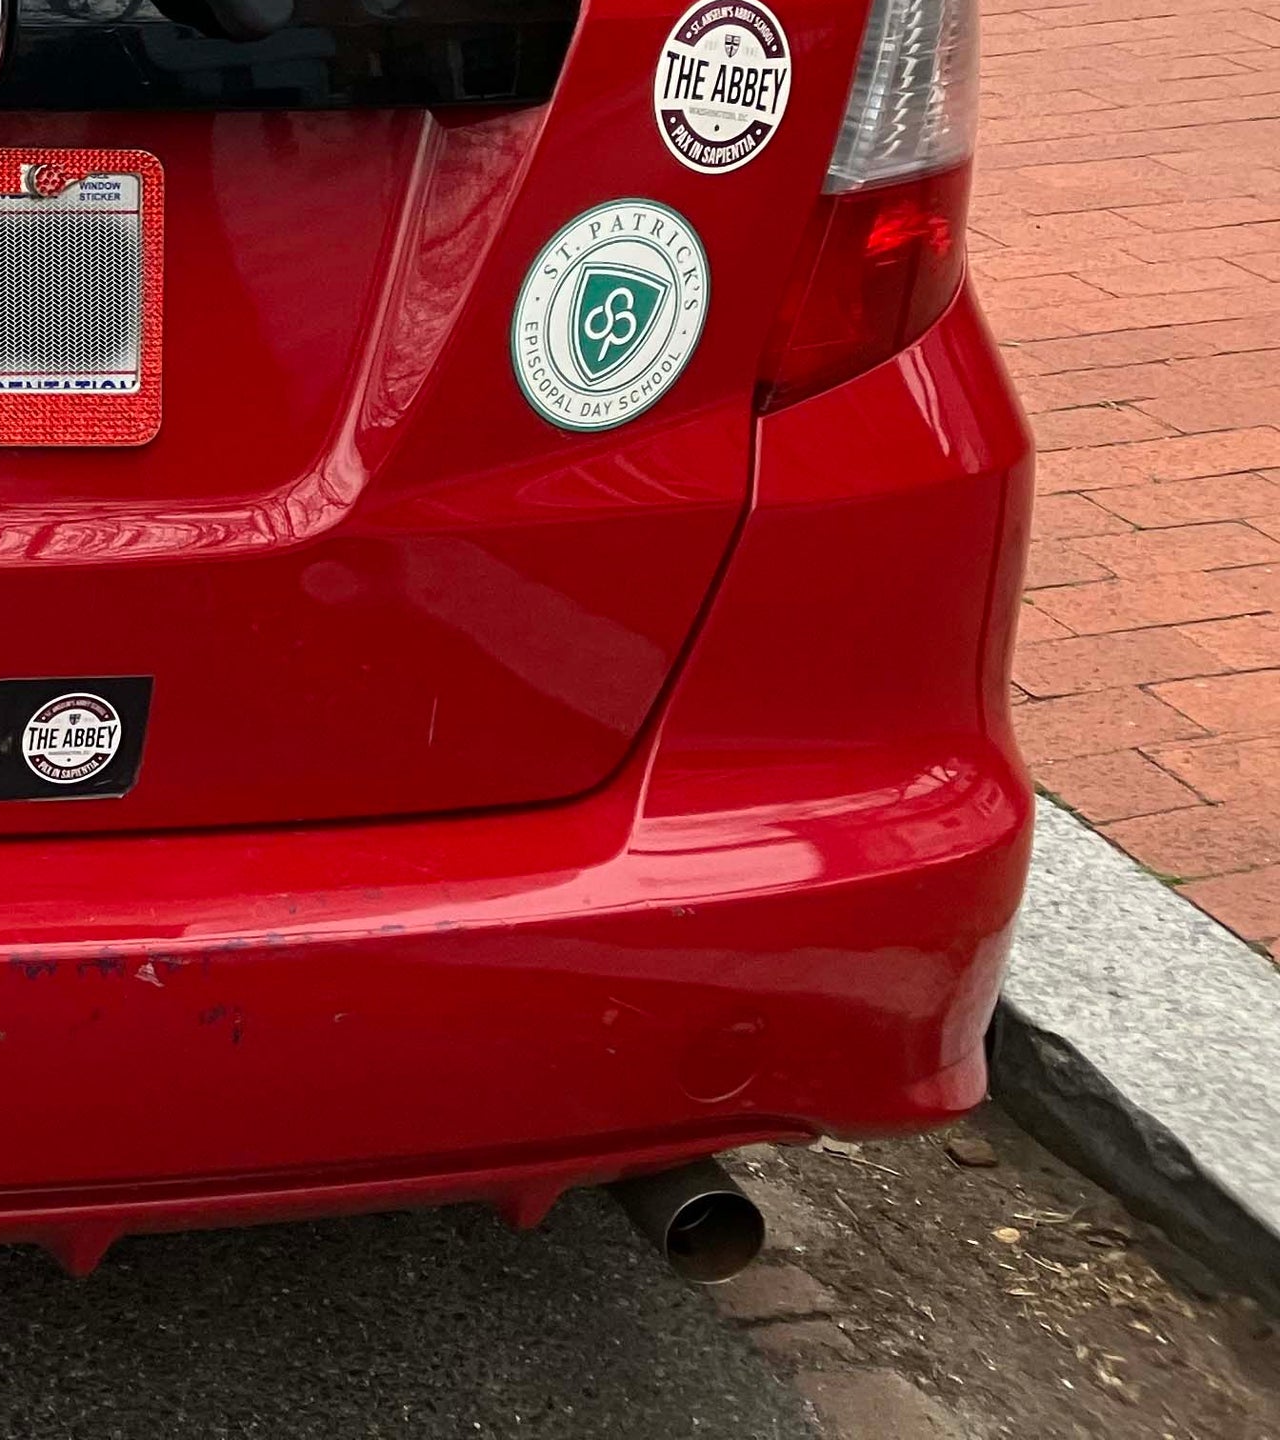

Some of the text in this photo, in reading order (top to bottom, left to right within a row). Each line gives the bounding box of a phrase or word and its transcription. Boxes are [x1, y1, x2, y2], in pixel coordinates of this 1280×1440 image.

[663, 50, 787, 115] THE ABBEY
[671, 124, 756, 165] PAX IN SAPIENTIA
[79, 181, 121, 190] WINDOW
[80, 192, 121, 201] STICKER
[543, 212, 700, 312] ST. PATRICK'S
[525, 320, 682, 418] EPISCOPAL DAY SCHOOL
[28, 724, 118, 751] THE ABBEY
